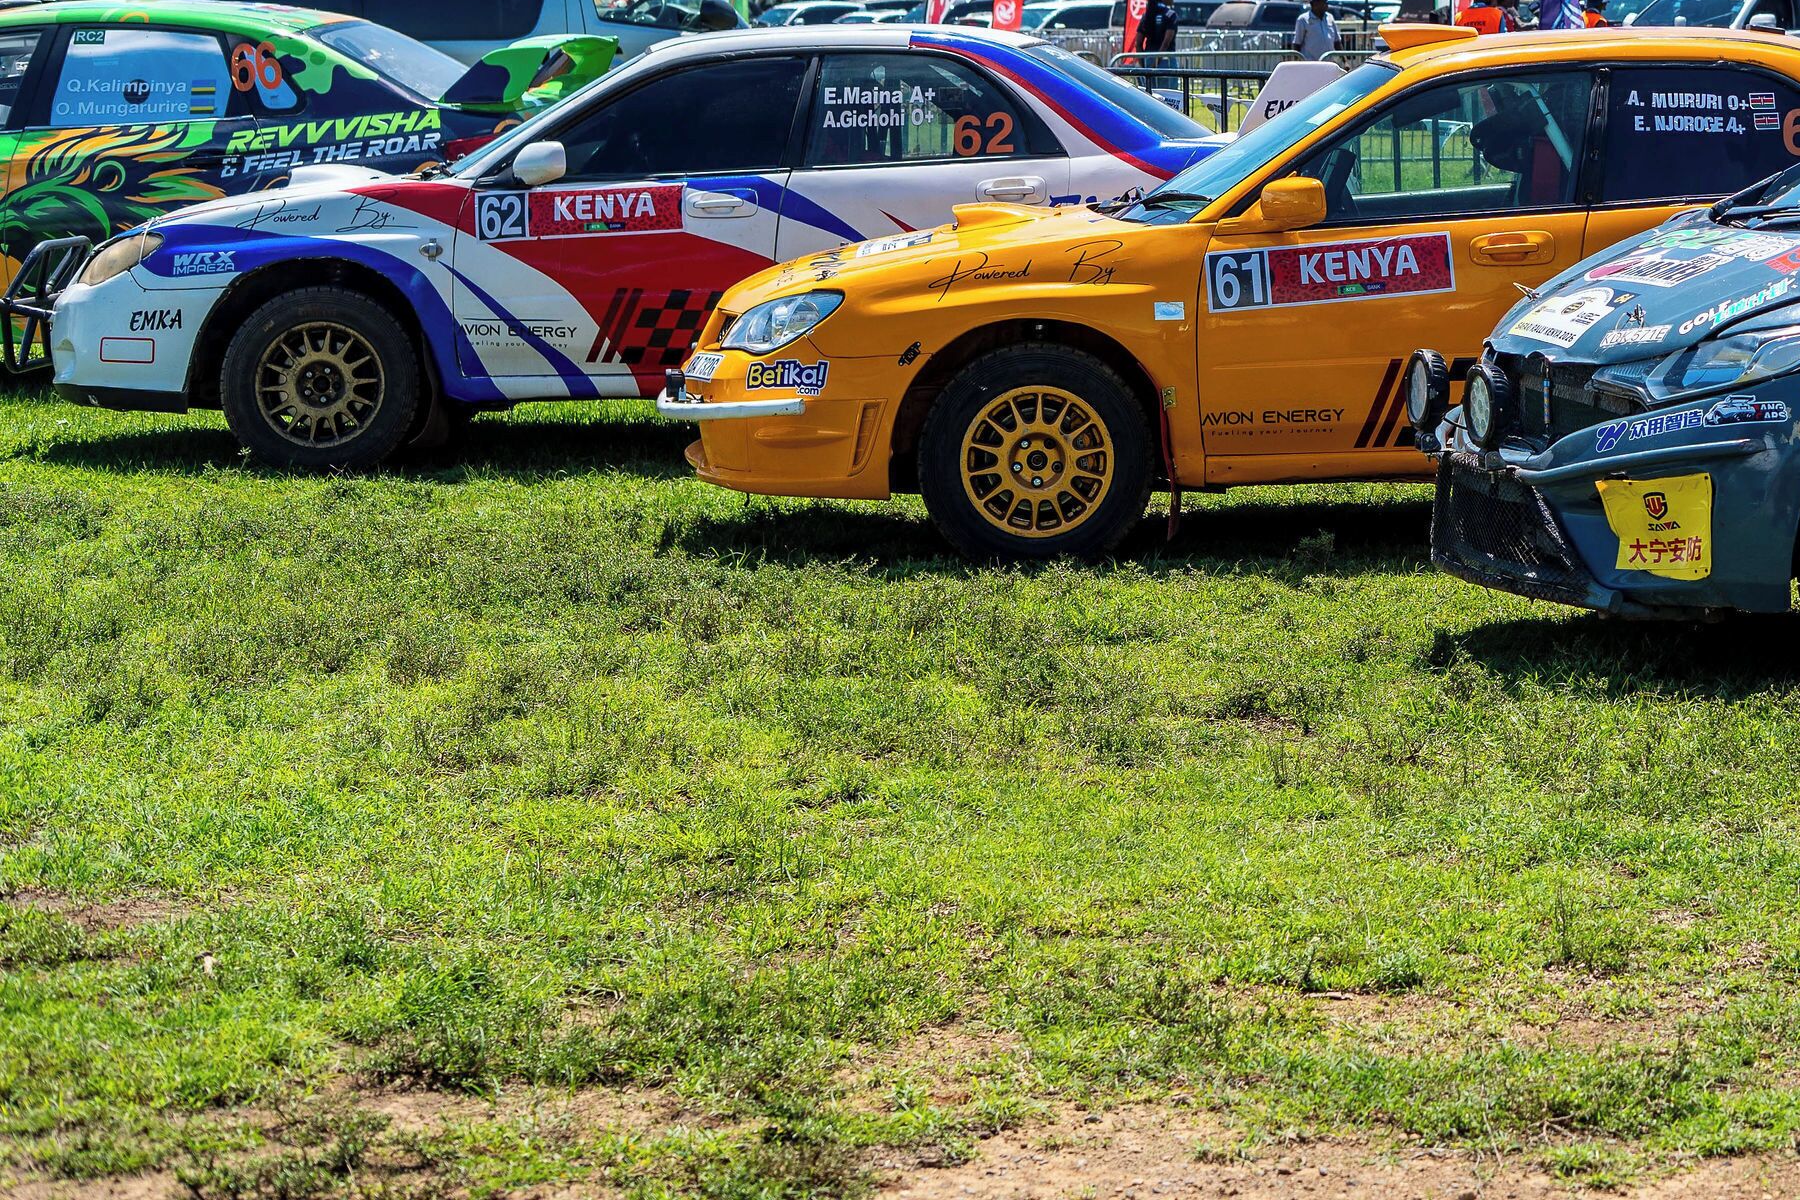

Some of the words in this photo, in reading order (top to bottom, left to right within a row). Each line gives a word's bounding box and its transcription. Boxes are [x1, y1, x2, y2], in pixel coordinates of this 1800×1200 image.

[75, 30, 105, 43] RC2
[231, 41, 282, 92] 66
[67, 79, 187, 96] Q.Kalimpinya
[824, 86, 903, 105] E.Maina
[909, 86, 936, 104] A+
[1651, 92, 1722, 110] MUIRURI
[823, 108, 905, 128] A.Gichohi
[1634, 115, 1651, 132] E.
[1654, 115, 1724, 133] NJOROGE
[1725, 116, 1746, 134] A+
[226, 109, 442, 154] REVVVISHA
[954, 112, 1014, 156] 62
[243, 150, 304, 173] FEEL
[312, 141, 368, 164] THE
[366, 132, 442, 157] ROAR
[236, 199, 322, 239] Powered
[480, 195, 522, 239] 62
[553, 191, 656, 222] KENYA
[173, 262, 235, 275] IMPREZA
[174, 251, 236, 266] WRX
[1300, 244, 1419, 285] KENYA
[929, 252, 1033, 302] Powered
[1216, 253, 1264, 307] 61
[129, 309, 183, 332] EMKA
[1679, 300, 1733, 335] GOLF
[1544, 327, 1559, 340] KENYA
[1558, 330, 1577, 343] 2026
[1601, 330, 1632, 346] KDK
[749, 361, 827, 388] Betika!
[796, 387, 820, 397] .com
[1202, 410, 1254, 426] AVION
[1262, 408, 1345, 423] ENERGY
[1628, 409, 1704, 441] 众用智造
[1212, 429, 1254, 437] Fueling
[1629, 536, 1703, 564] 大宁安防
